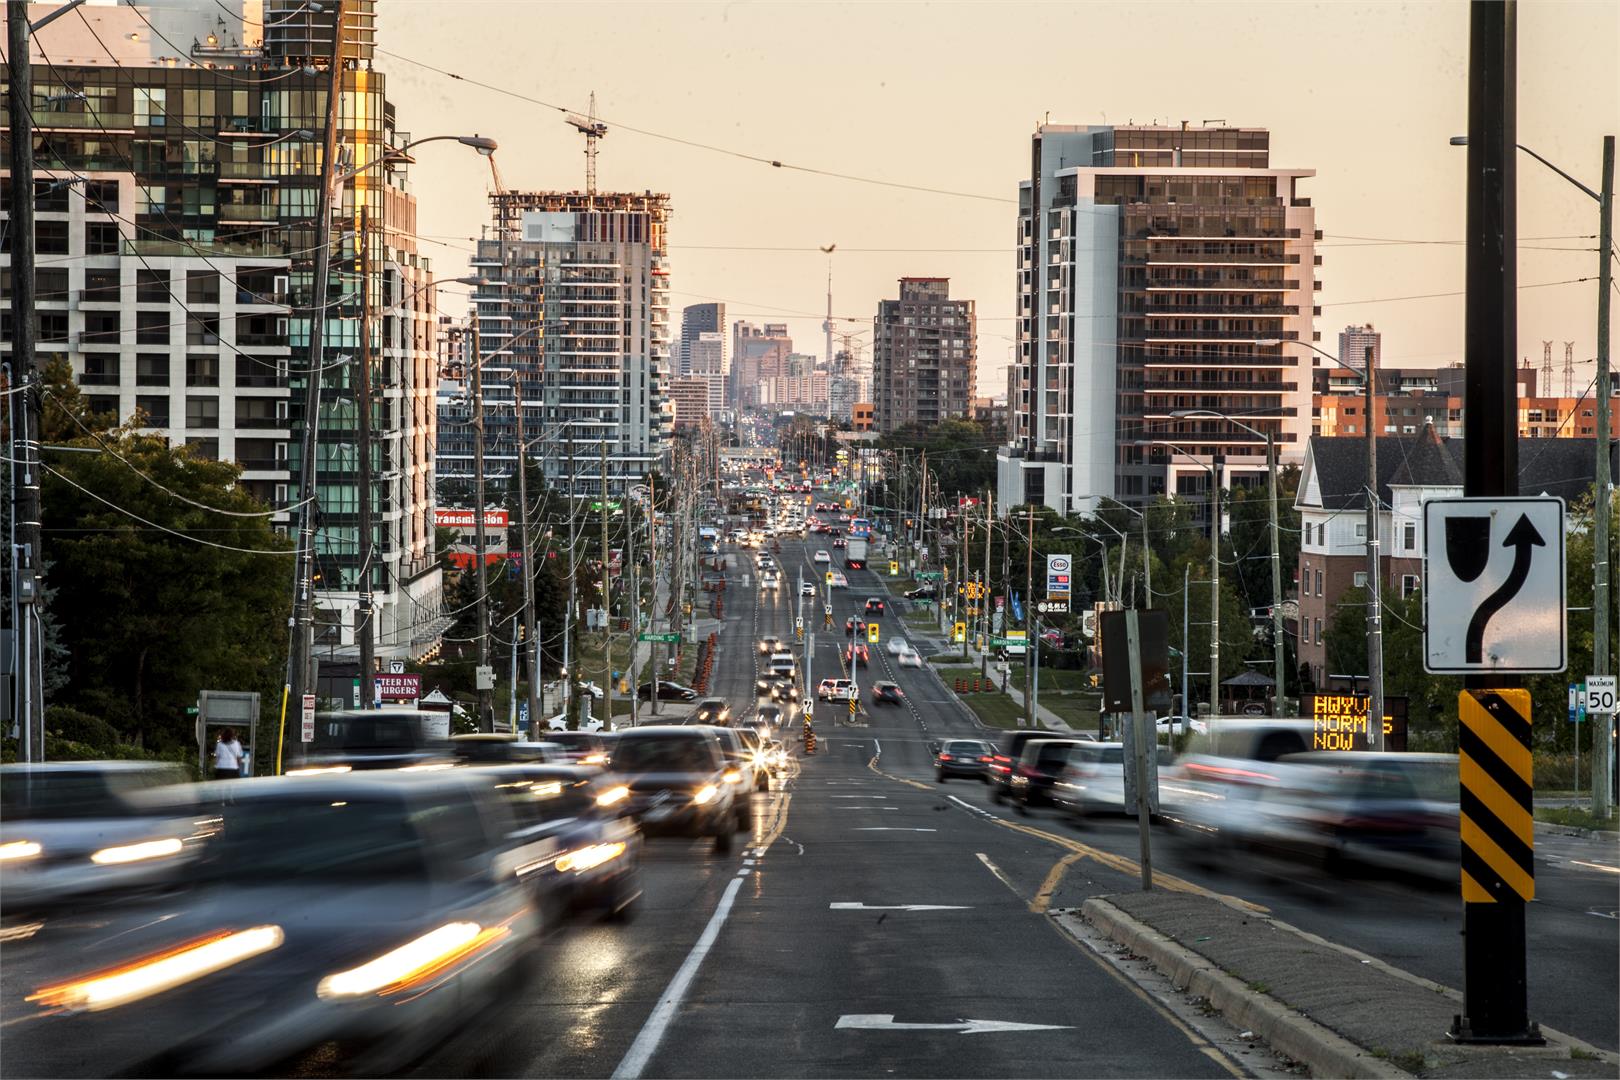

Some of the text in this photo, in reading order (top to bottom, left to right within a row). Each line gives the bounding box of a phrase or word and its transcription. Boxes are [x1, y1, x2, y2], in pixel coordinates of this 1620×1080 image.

[380, 678, 418, 686] TEER INN
[1590, 692, 1613, 708] 50
[1313, 732, 1353, 751] NOW
